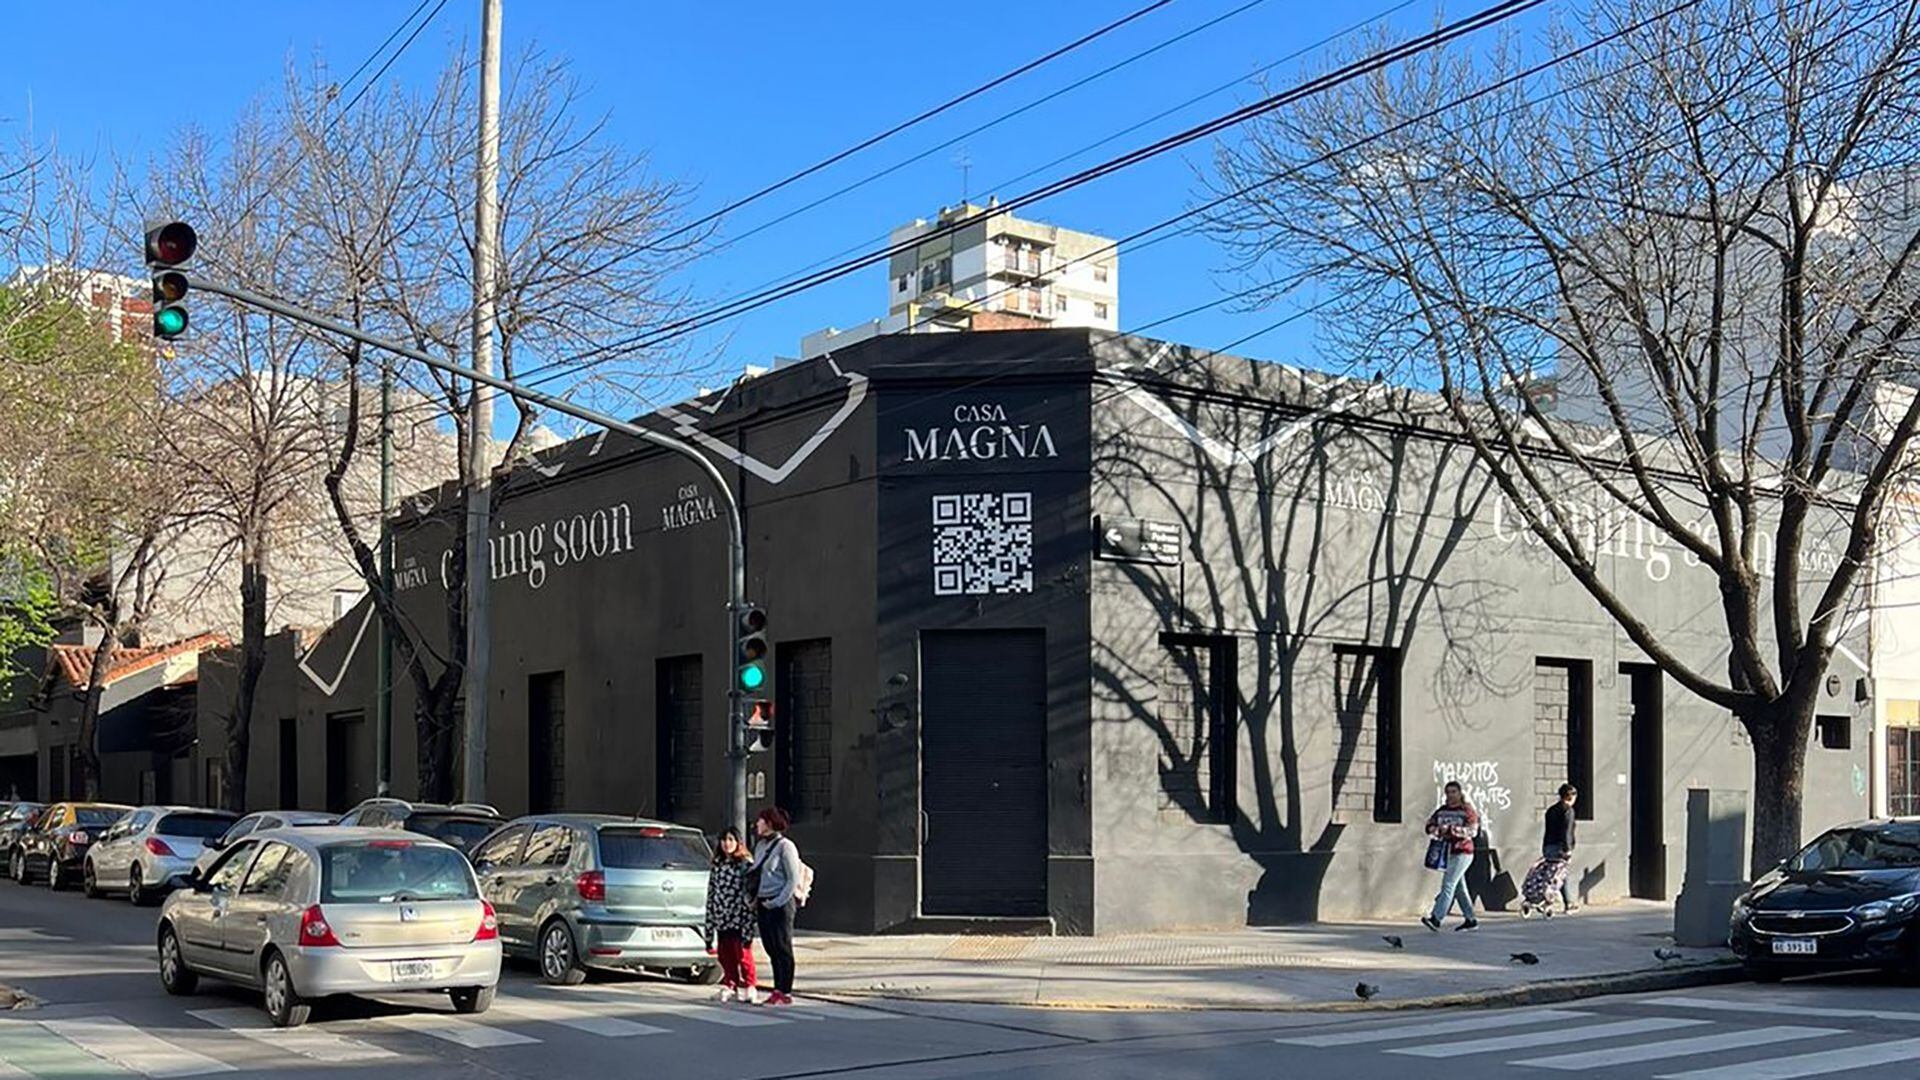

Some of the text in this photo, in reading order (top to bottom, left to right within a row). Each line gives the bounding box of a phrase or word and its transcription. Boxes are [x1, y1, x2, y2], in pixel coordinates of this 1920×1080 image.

[953, 404, 1007, 423] CASA
[904, 424, 1059, 462] MAGNA
[662, 496, 717, 531] MAGNA
[441, 502, 634, 589] cing soon
[1798, 550, 1838, 575] MAGN
[1433, 760, 1498, 786] MALDITOS
